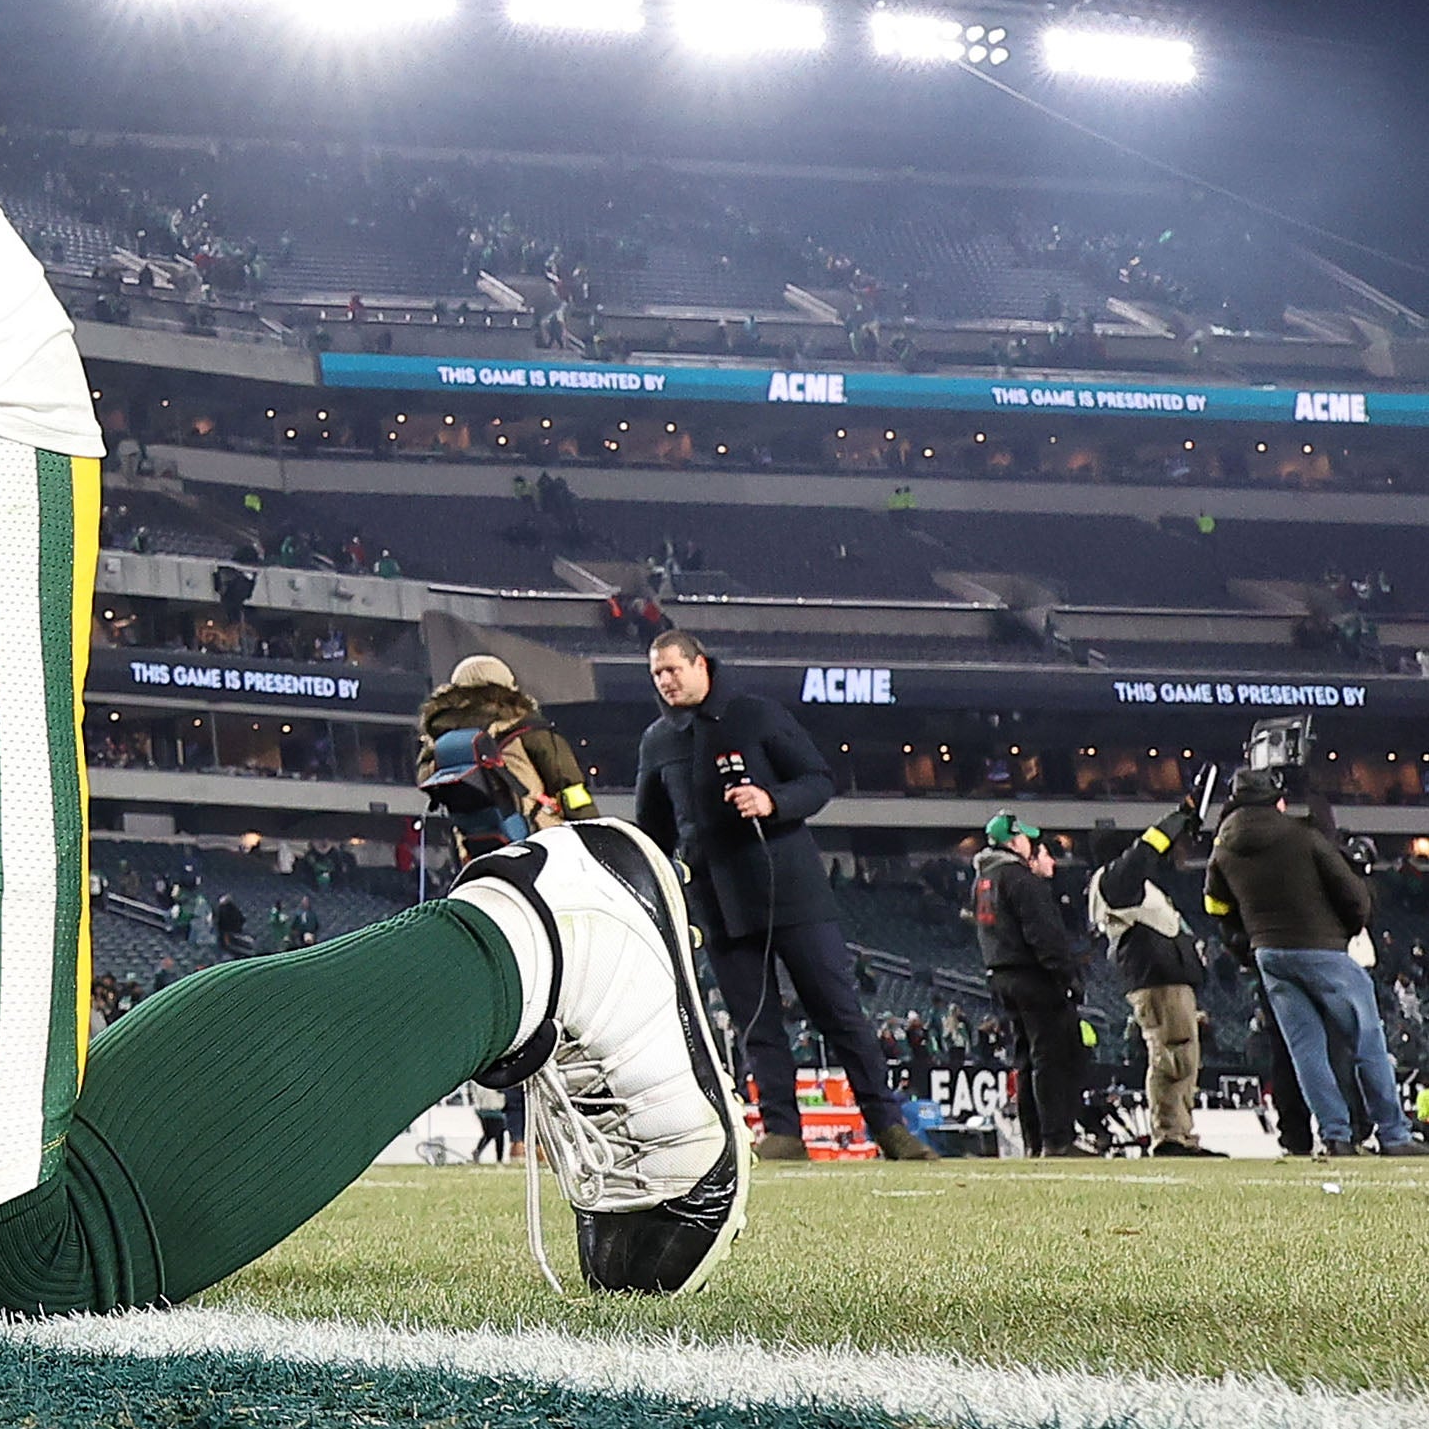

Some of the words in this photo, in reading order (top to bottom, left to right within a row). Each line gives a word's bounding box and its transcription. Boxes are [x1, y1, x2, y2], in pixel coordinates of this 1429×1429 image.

[437, 365, 476, 385] THIS
[479, 368, 527, 388] GAME
[530, 370, 545, 387] IS
[549, 370, 643, 391] PRESENTED
[644, 373, 666, 392] BY
[991, 387, 1028, 405] THIS
[1032, 388, 1076, 408] GAME
[1078, 389, 1095, 408] IS
[1097, 390, 1183, 411] PRESENTED
[1187, 394, 1207, 412] BY
[130, 662, 170, 684] THIS
[173, 665, 222, 689] GAME
[224, 670, 242, 690] IS
[244, 671, 335, 698] PRESENTED
[338, 678, 360, 700] BY
[1114, 681, 1157, 703] THIS
[1160, 682, 1213, 705] GAME
[1216, 683, 1235, 705] IS
[1238, 684, 1340, 708] PRESENTED
[1343, 685, 1366, 707] BY
